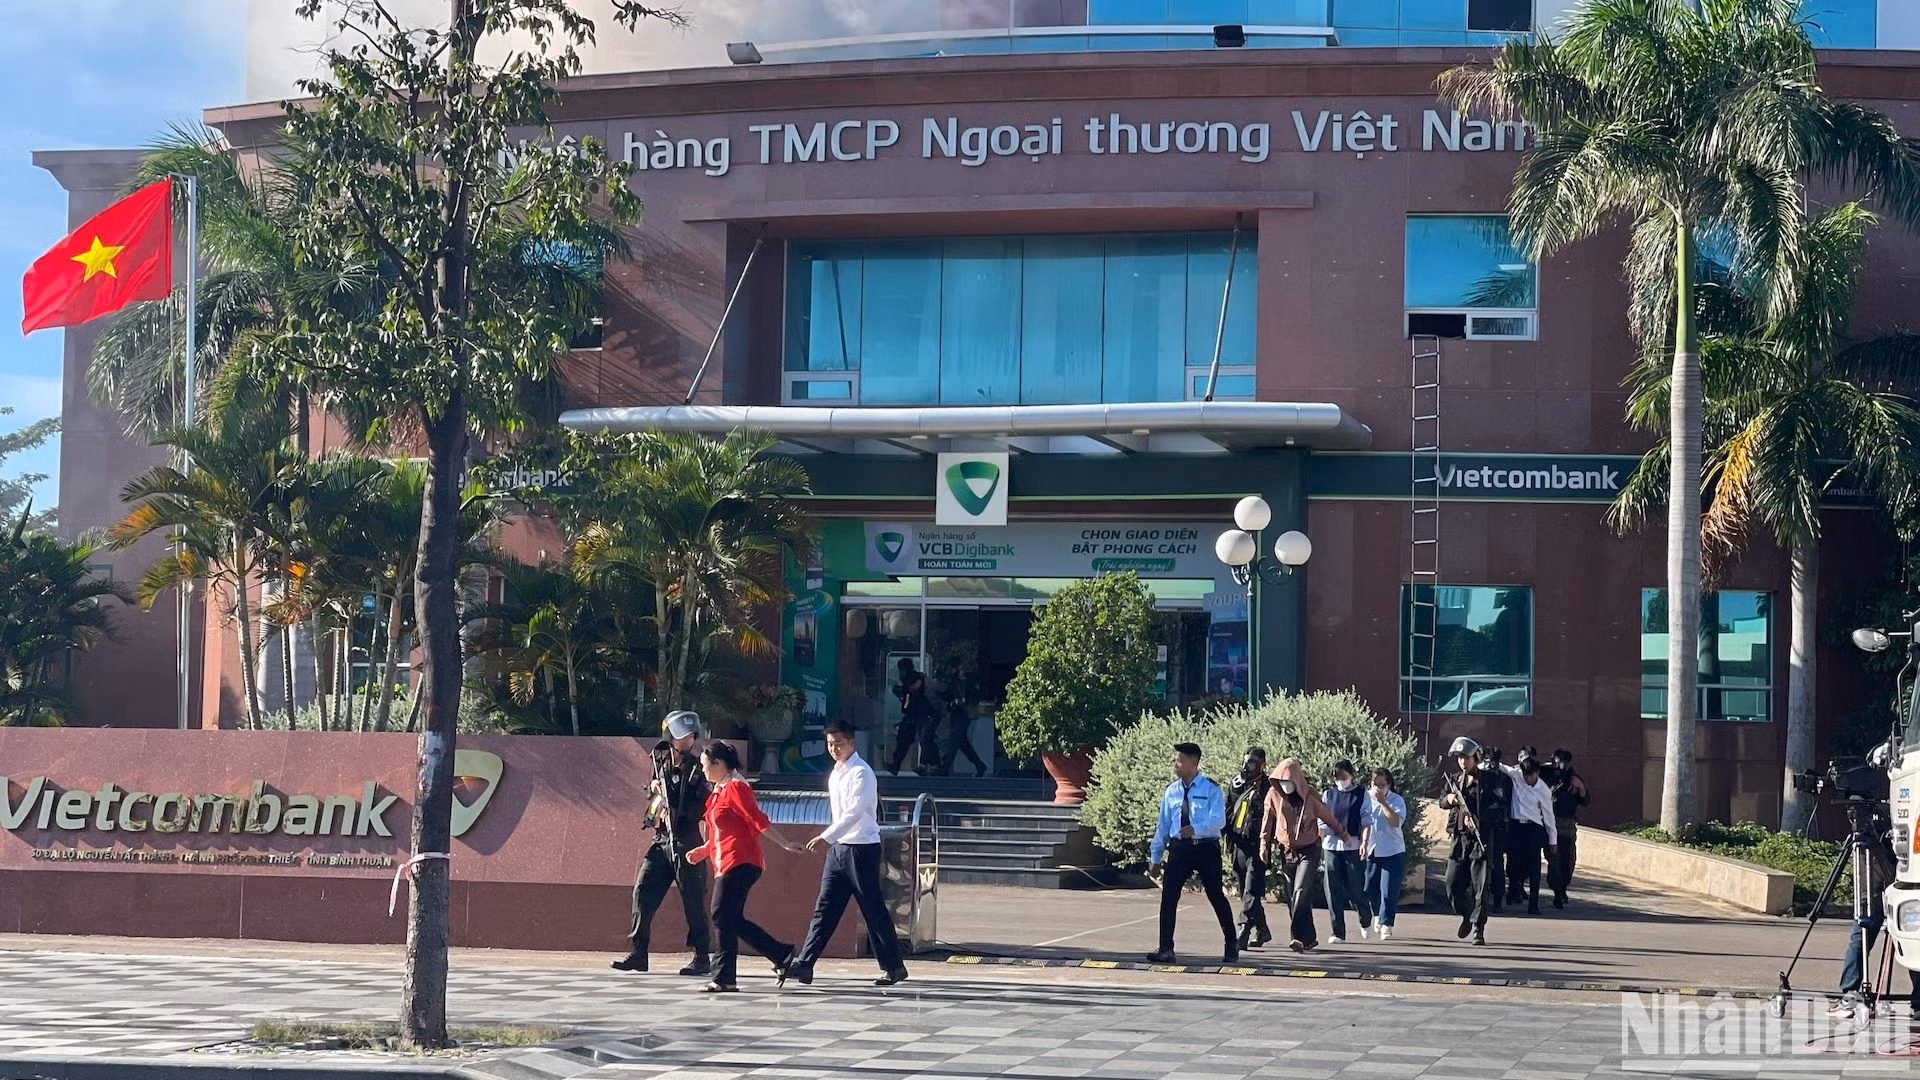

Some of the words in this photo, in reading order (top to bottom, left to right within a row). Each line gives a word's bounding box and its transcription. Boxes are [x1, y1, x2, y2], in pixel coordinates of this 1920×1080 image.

[624, 130, 731, 177] hàng
[748, 118, 900, 165] TMCP
[922, 116, 1062, 167] Ngoại
[1084, 111, 1271, 163] thương
[1291, 109, 1399, 159] Việt
[1433, 464, 1620, 491] Vietcombank
[918, 532, 941, 541] Ngân
[943, 532, 963, 541] hàng
[966, 531, 976, 540] số
[1081, 529, 1121, 541] CHỌN
[1125, 529, 1160, 540] GIAO
[1164, 528, 1199, 542] DIỆN
[1072, 542, 1099, 555] BẬT
[1103, 544, 1153, 554] PHONG
[1158, 543, 1196, 554] CÁCH
[0, 775, 399, 838] Vietcombank
